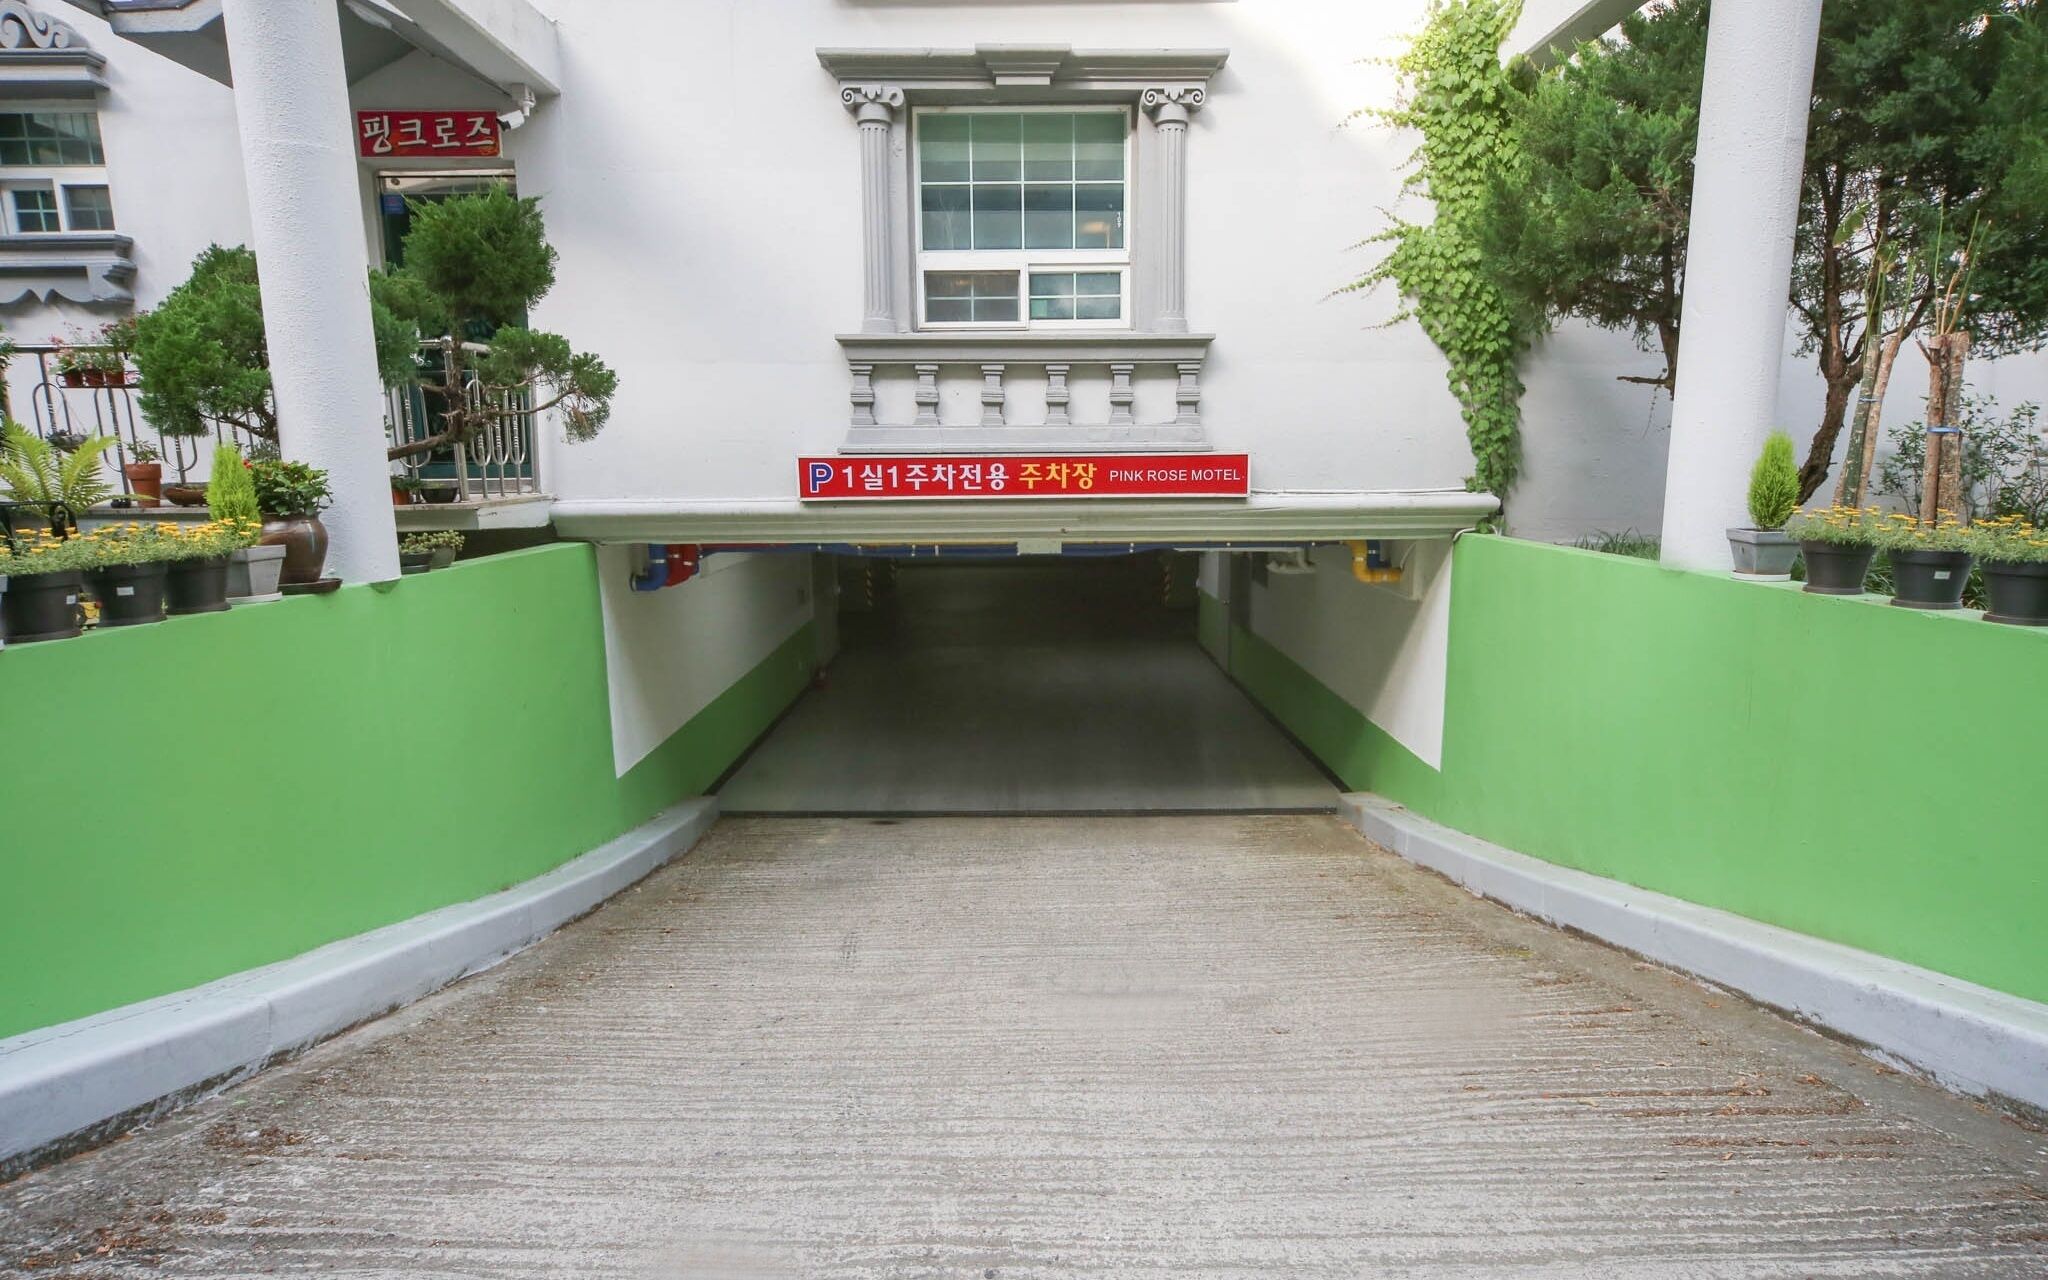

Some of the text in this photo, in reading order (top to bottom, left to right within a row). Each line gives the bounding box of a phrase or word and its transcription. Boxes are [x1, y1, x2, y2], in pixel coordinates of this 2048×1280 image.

[362, 114, 495, 154] 핑크로즈
[808, 462, 834, 494] P
[1018, 462, 1098, 490] 주차장
[1109, 469, 1144, 482] PINK
[1147, 469, 1187, 482] ROSE
[1191, 469, 1241, 481] MOTEL
